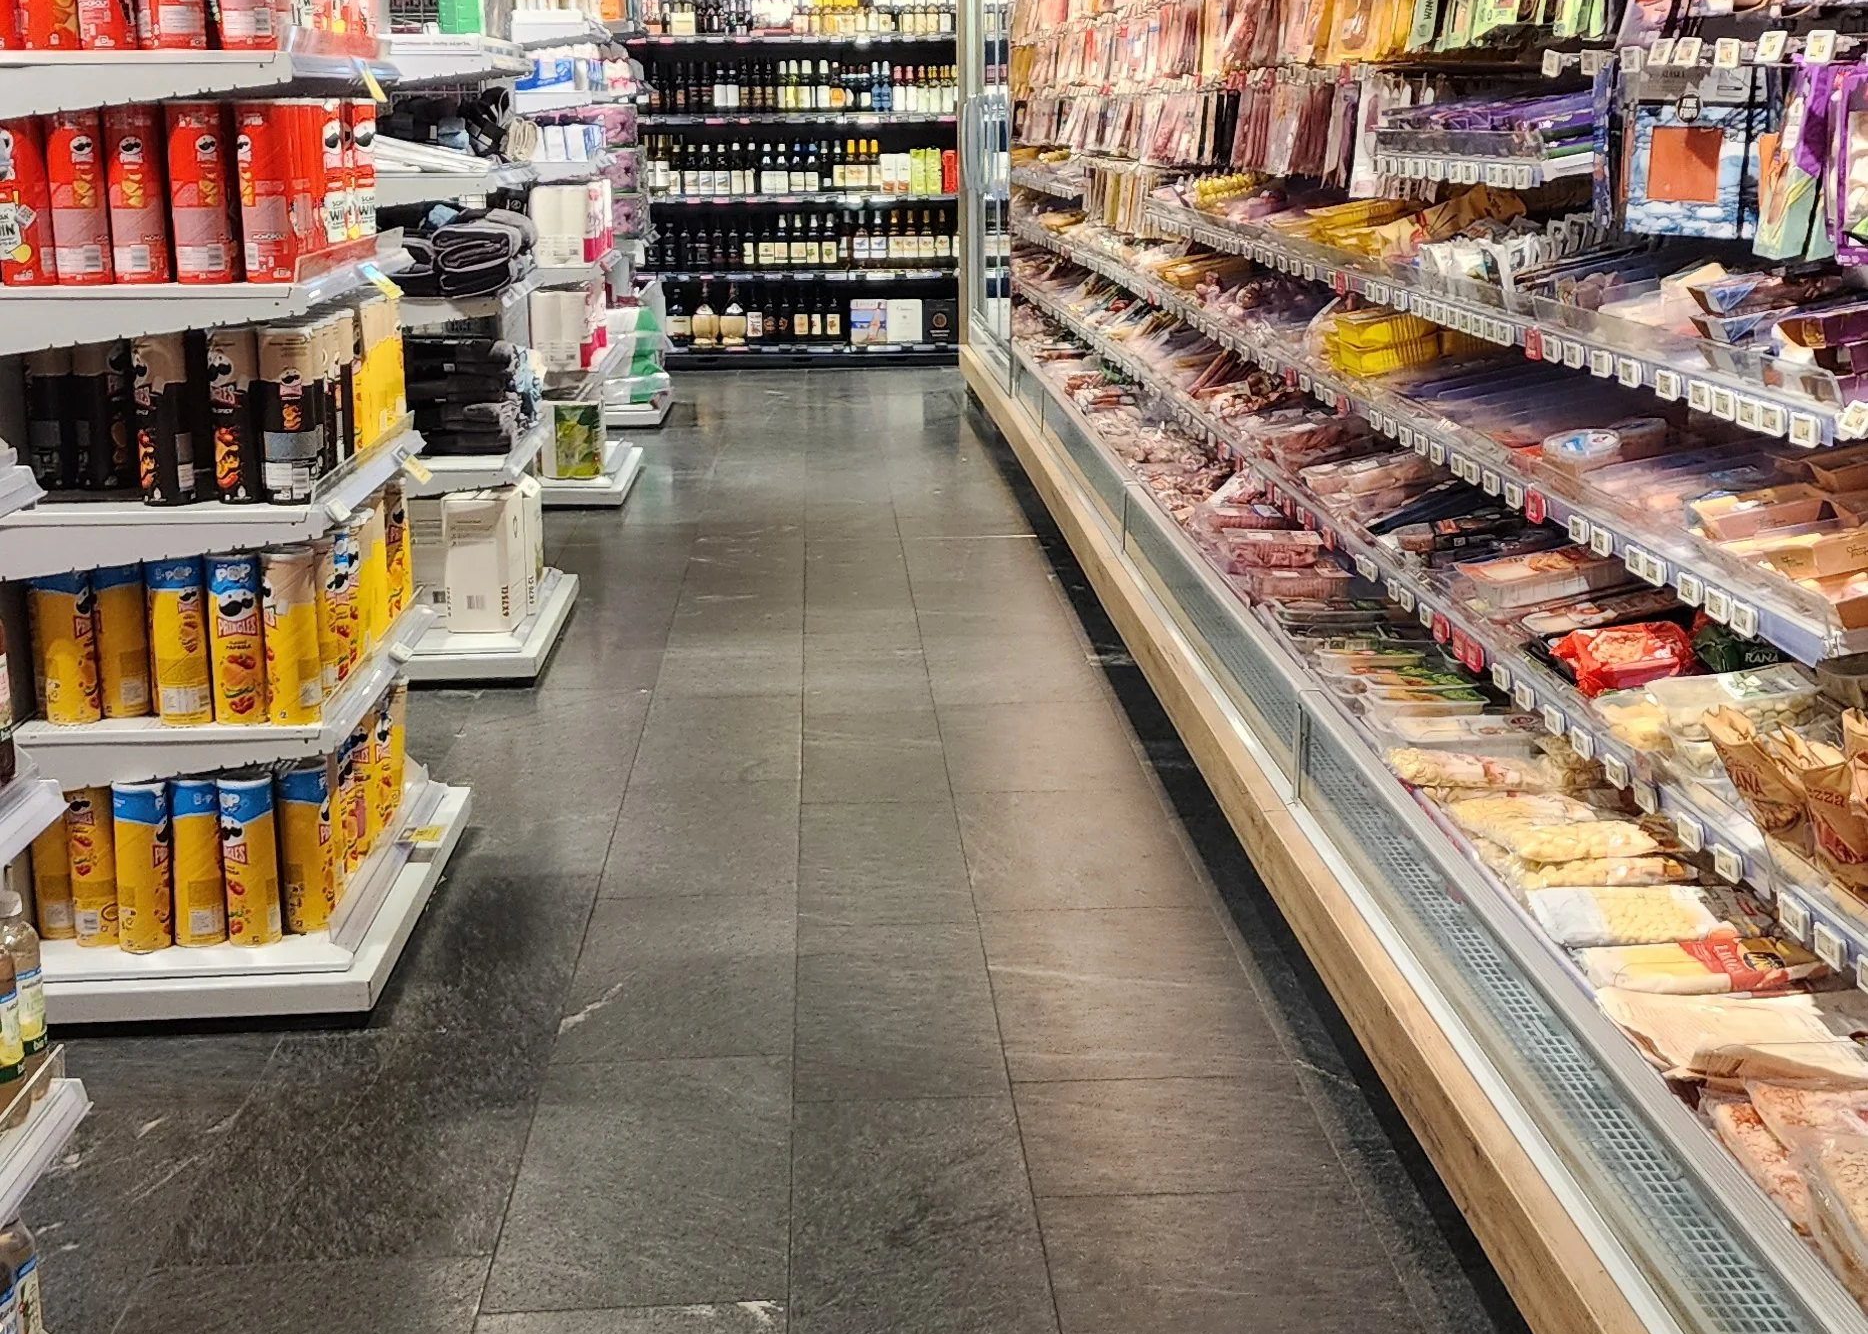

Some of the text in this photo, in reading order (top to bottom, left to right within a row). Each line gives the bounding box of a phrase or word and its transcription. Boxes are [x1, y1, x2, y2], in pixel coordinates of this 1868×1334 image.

[0, 223, 15, 237] IN
[501, 584, 510, 618] 6X75CL
[218, 618, 258, 637] PRINGLES
[1744, 651, 1780, 663] RANA
